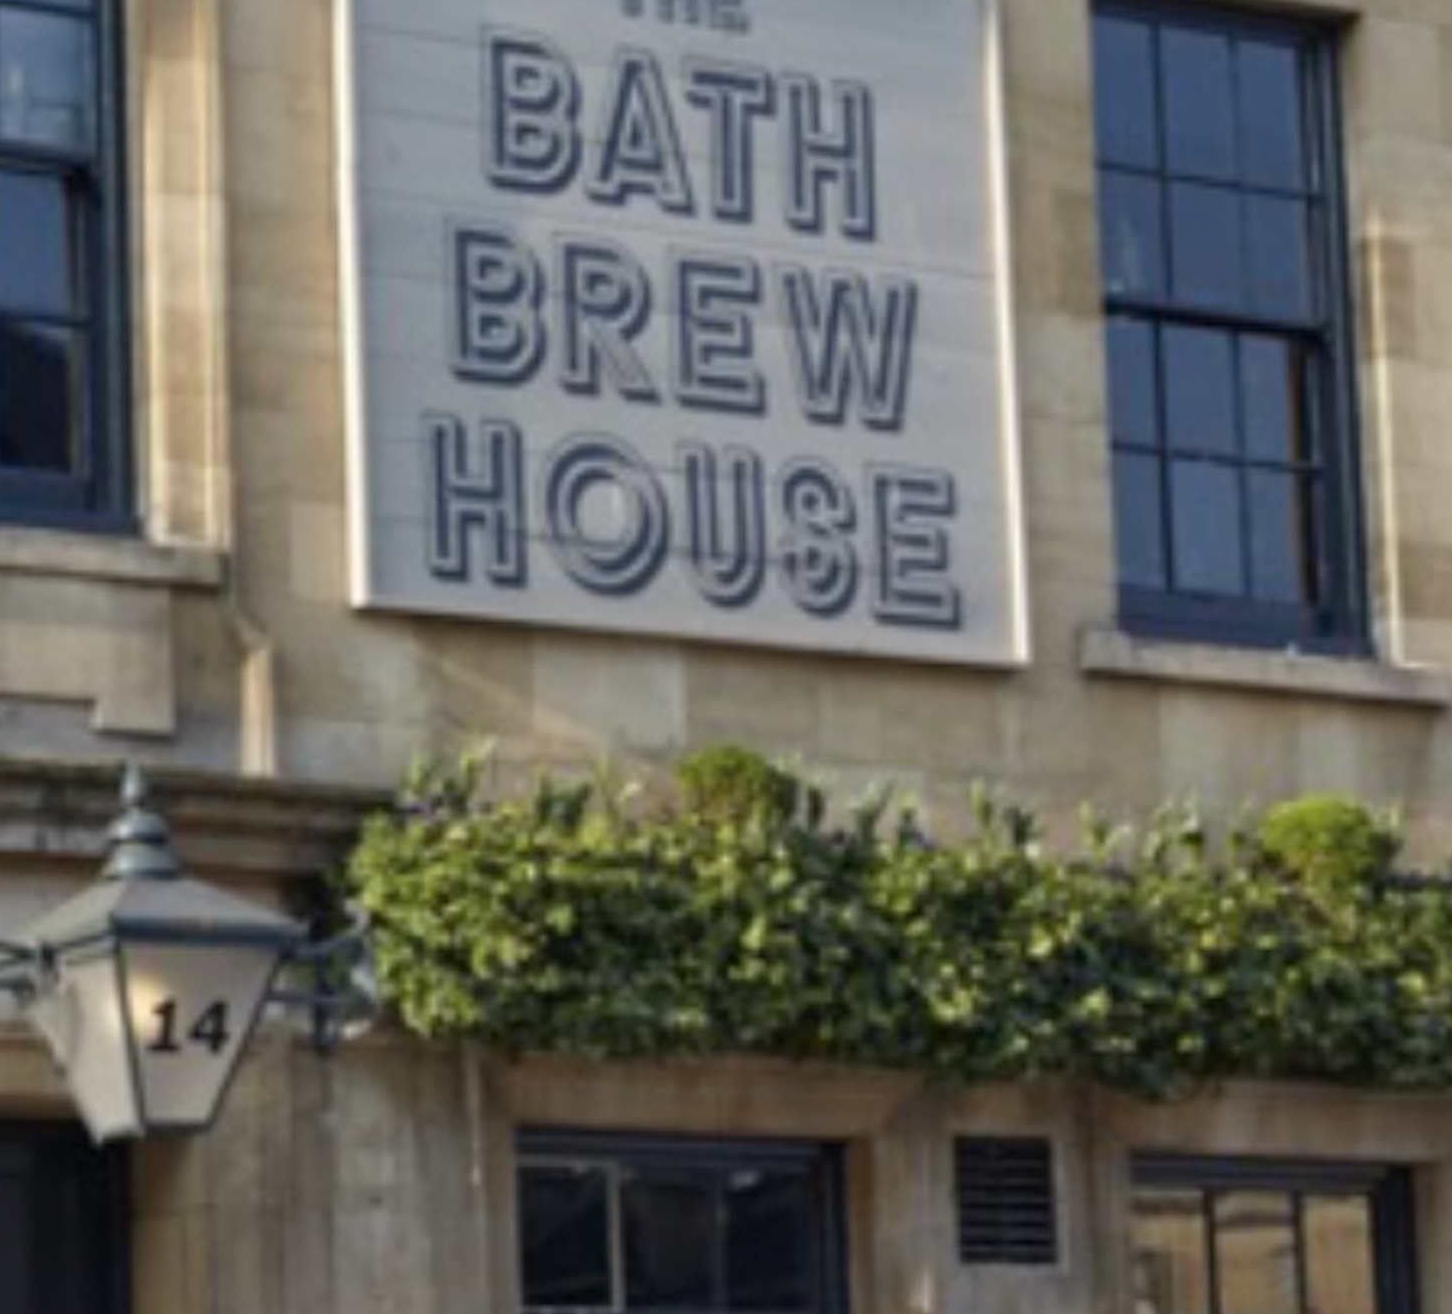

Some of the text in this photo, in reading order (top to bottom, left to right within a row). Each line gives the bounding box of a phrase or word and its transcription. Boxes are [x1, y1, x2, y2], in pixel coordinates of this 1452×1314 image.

[482, 27, 878, 241] BATH
[446, 218, 920, 433] BREW
[423, 413, 963, 631] HOUSE
[146, 996, 228, 1053] 14
